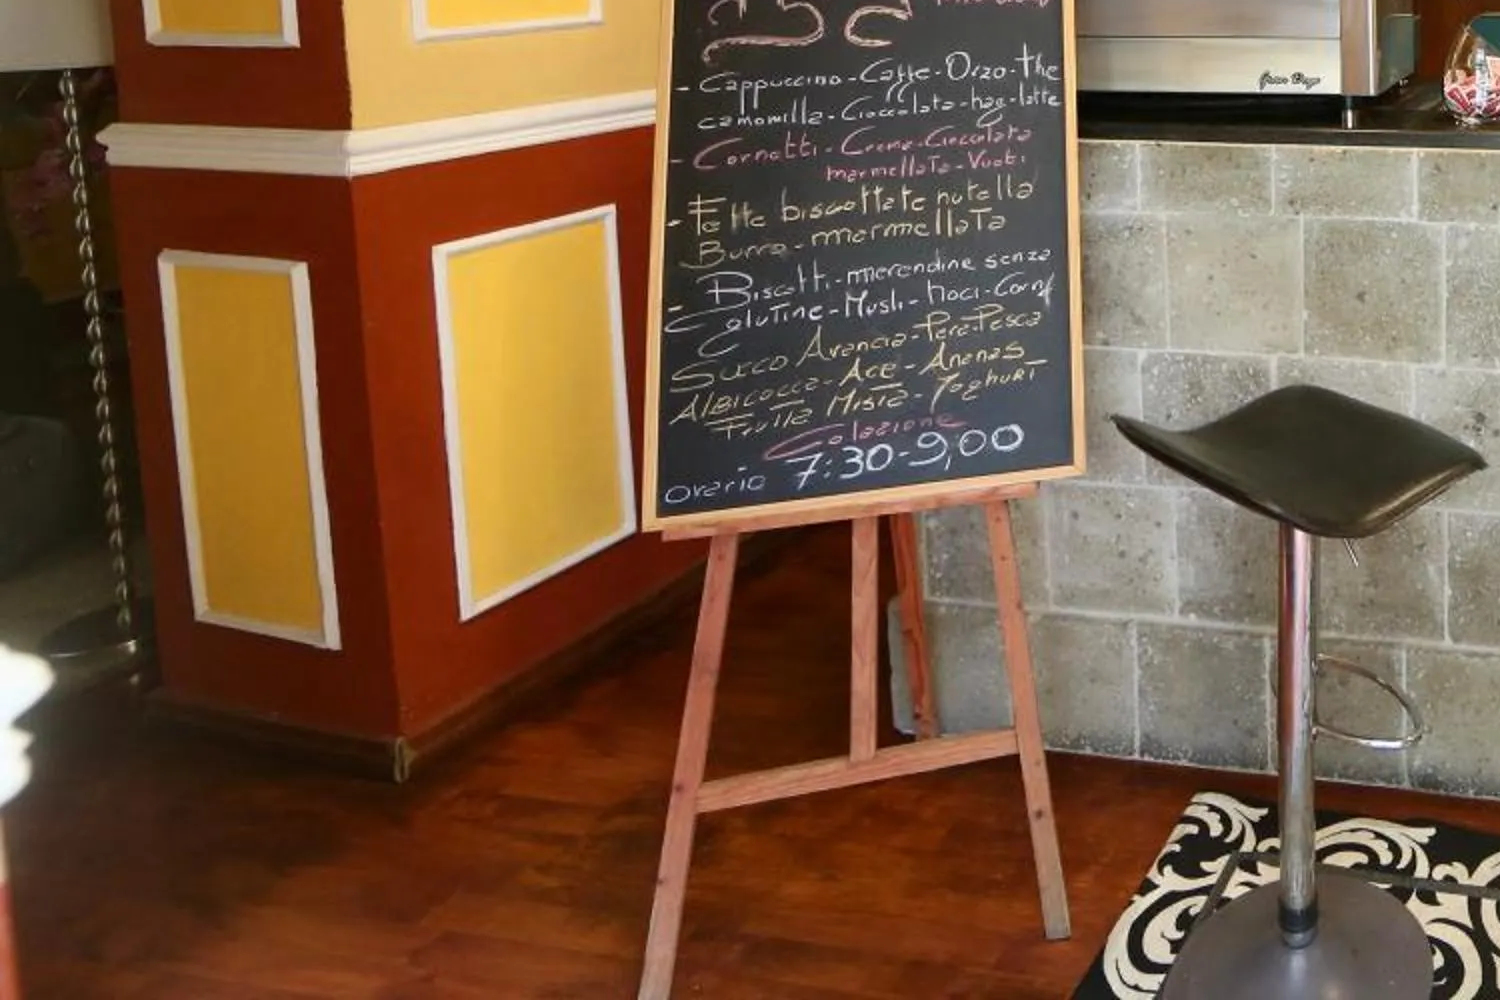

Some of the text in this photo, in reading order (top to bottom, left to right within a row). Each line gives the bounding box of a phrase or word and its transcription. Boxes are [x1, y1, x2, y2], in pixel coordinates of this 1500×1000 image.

[699, 72, 842, 115] Cappuccino
[945, 51, 1006, 81] Orzo
[1019, 80, 1062, 107] latte
